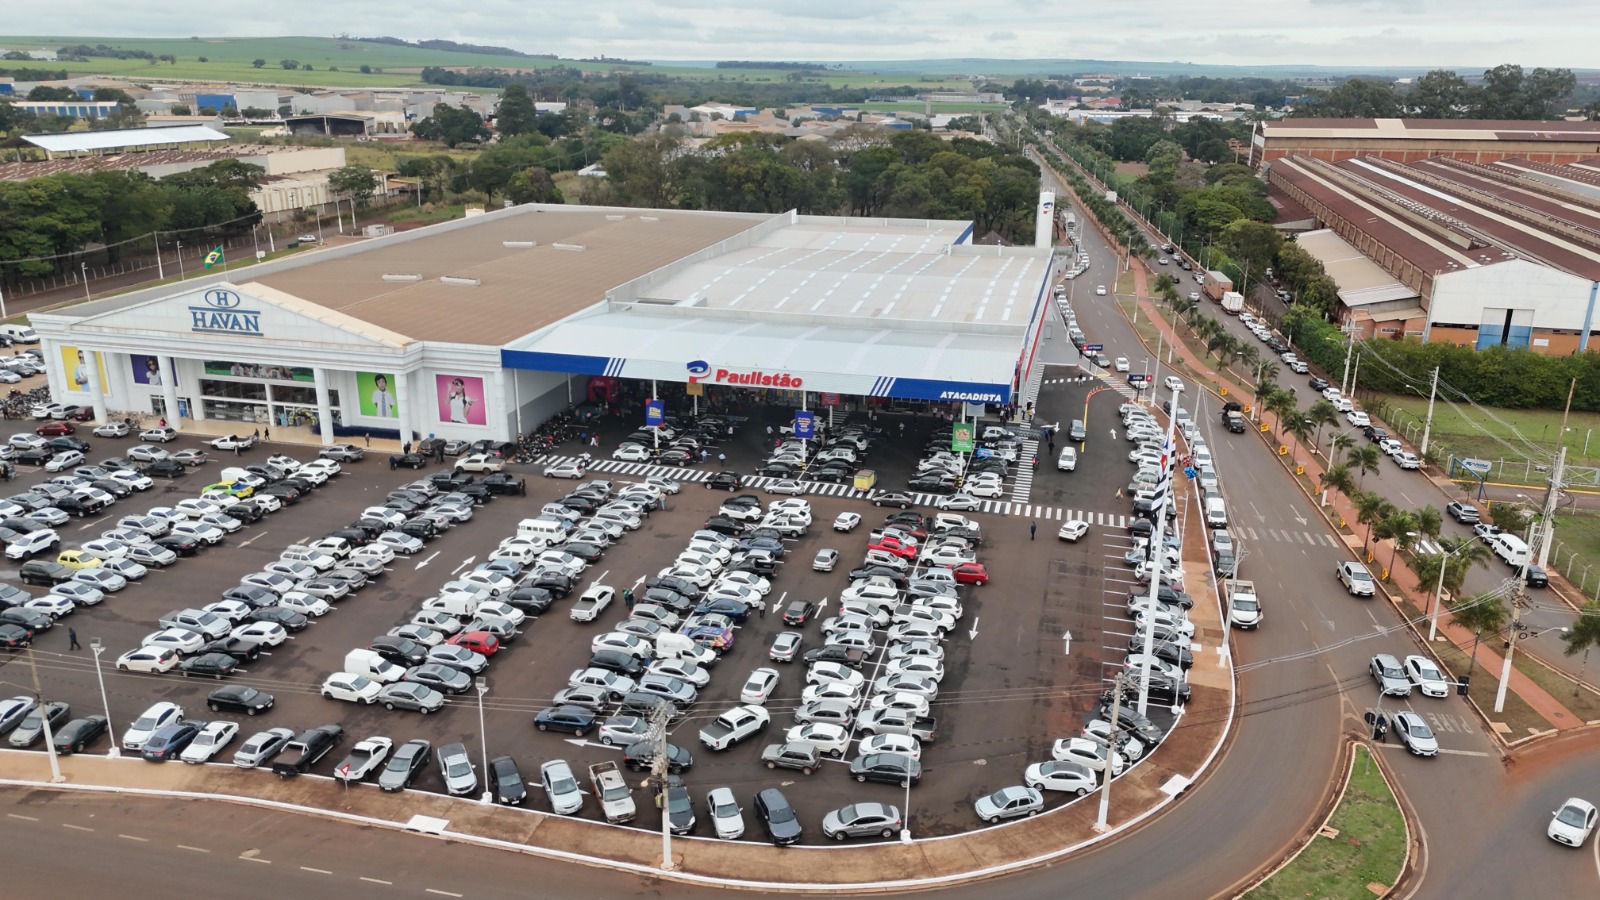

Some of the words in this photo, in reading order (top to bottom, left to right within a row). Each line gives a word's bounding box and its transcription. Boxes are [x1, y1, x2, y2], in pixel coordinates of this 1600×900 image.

[215, 291, 229, 306] H
[191, 311, 259, 332] HAVAN
[715, 369, 803, 388] Paulistão
[940, 391, 1002, 402] ATACADISTA
